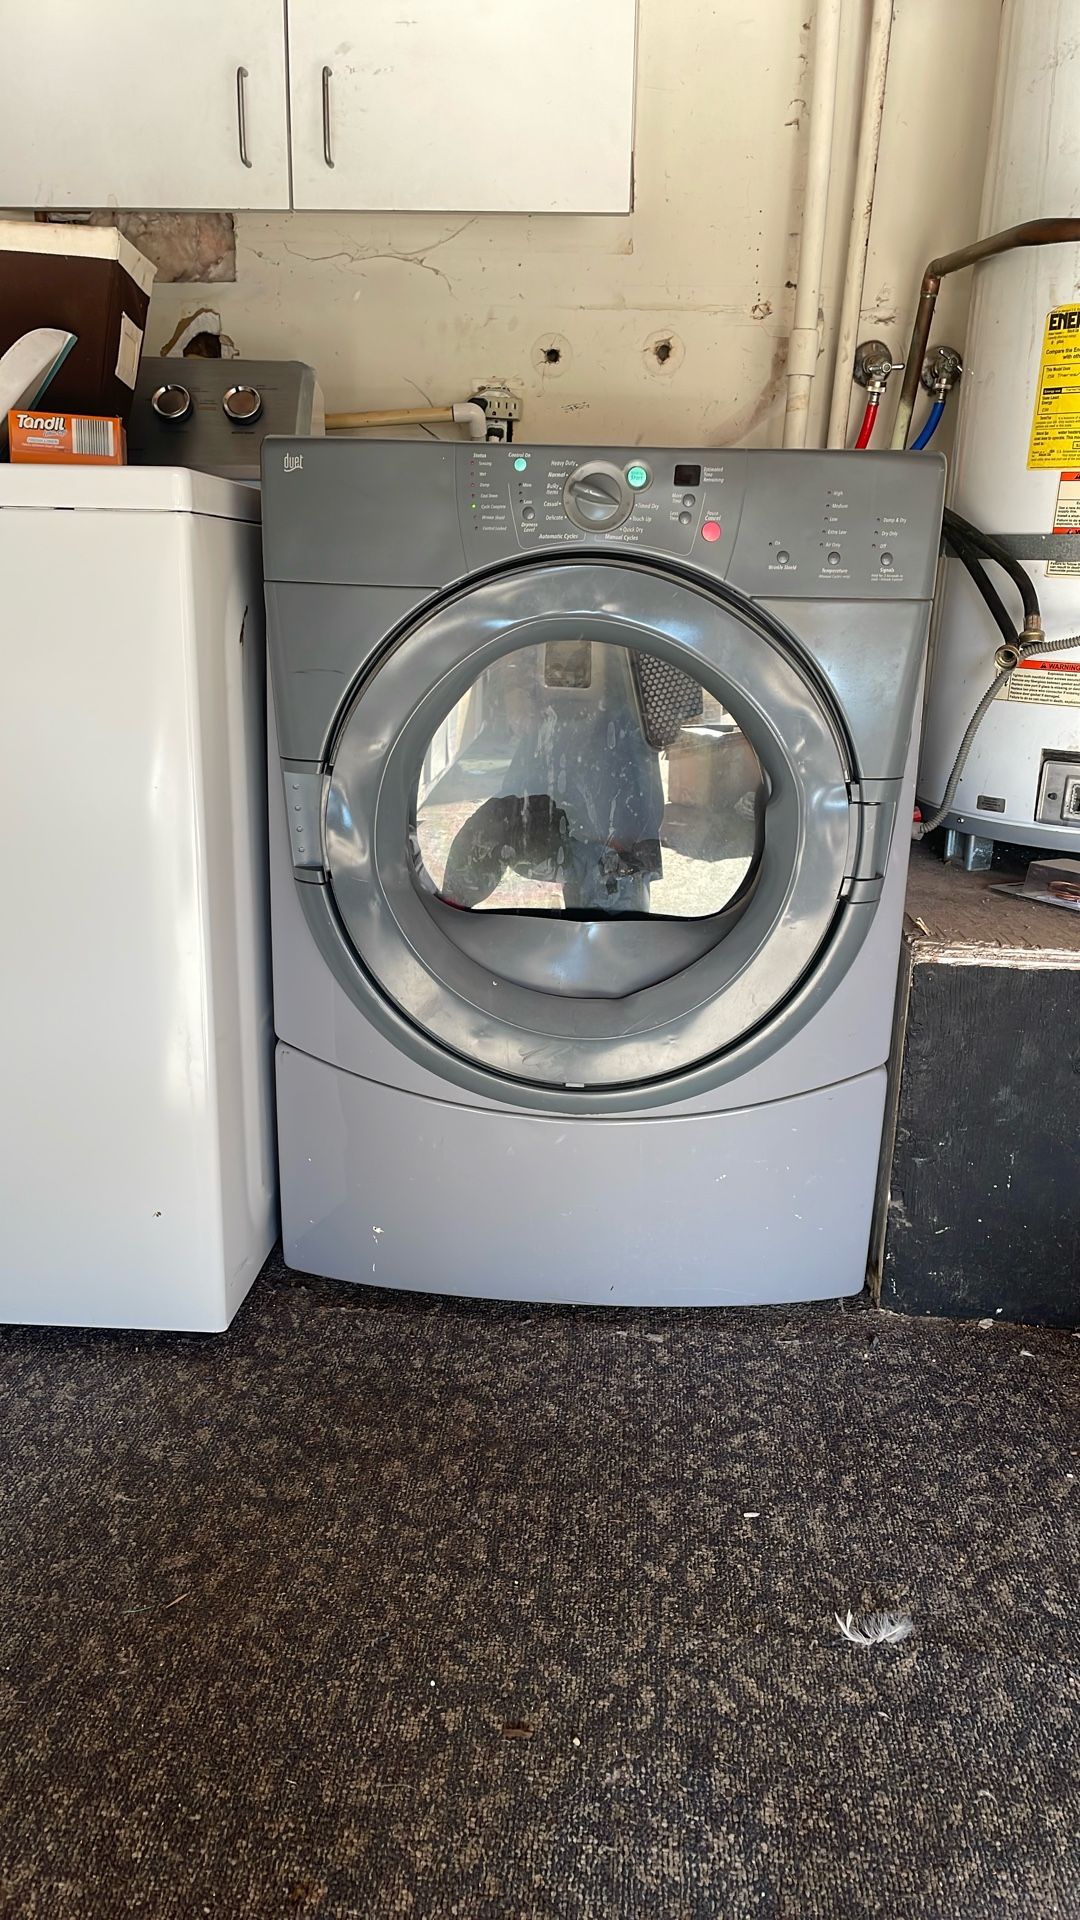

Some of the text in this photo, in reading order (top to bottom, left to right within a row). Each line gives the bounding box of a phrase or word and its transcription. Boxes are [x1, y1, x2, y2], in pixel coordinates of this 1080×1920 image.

[1049, 312, 1080, 331] ENE
[17, 414, 66, 431] Tandil
[284, 452, 303, 472] duet
[1049, 663, 1080, 671] WARNING
